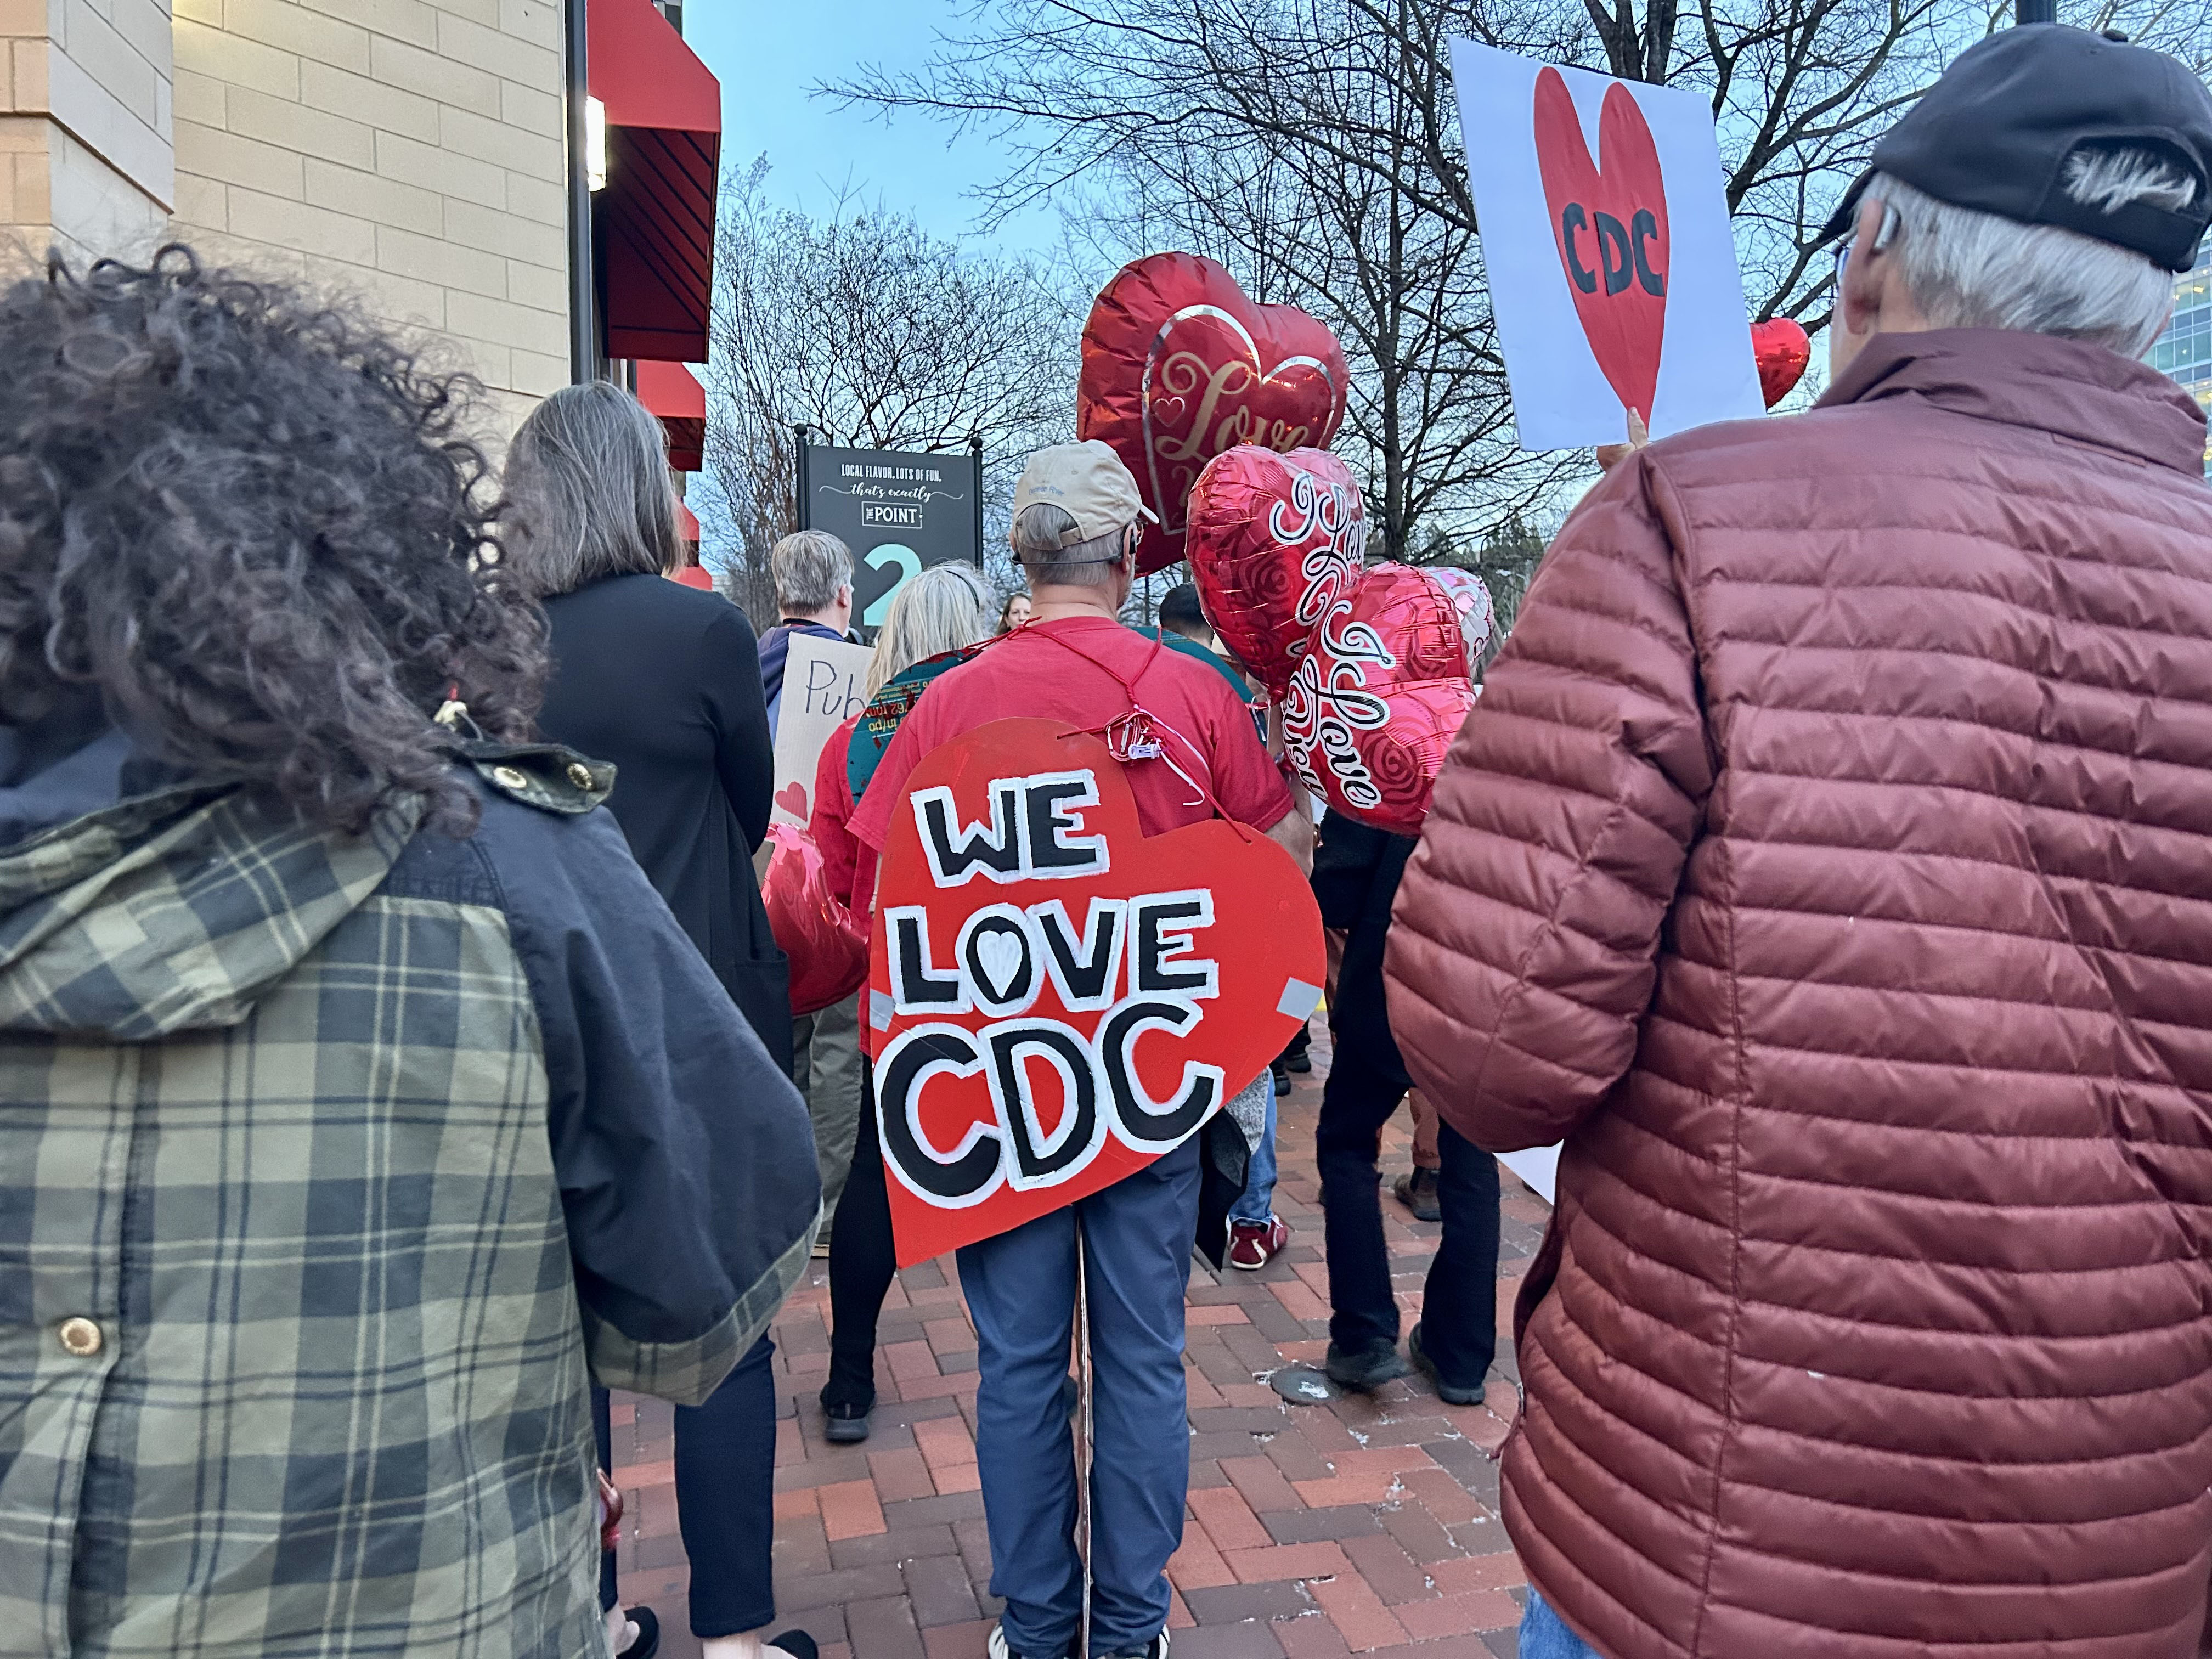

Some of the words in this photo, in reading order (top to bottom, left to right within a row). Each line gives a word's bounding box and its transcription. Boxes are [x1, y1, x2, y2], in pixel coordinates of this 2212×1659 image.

[1562, 202, 1664, 297] CDC
[1155, 351, 1308, 462] Love
[841, 464, 864, 477] LOCAL
[896, 468, 913, 481] LOTS
[915, 469, 924, 481] OF
[926, 470, 942, 482] FUN.
[850, 482, 885, 499] that's
[888, 486, 932, 503] exactly
[874, 506, 917, 523] POINT
[864, 543, 922, 627] 2
[1302, 653, 1391, 810] Love
[911, 769, 1110, 888] WE
[884, 888, 1220, 1018] LOVE
[874, 996, 1225, 1209] CDC
